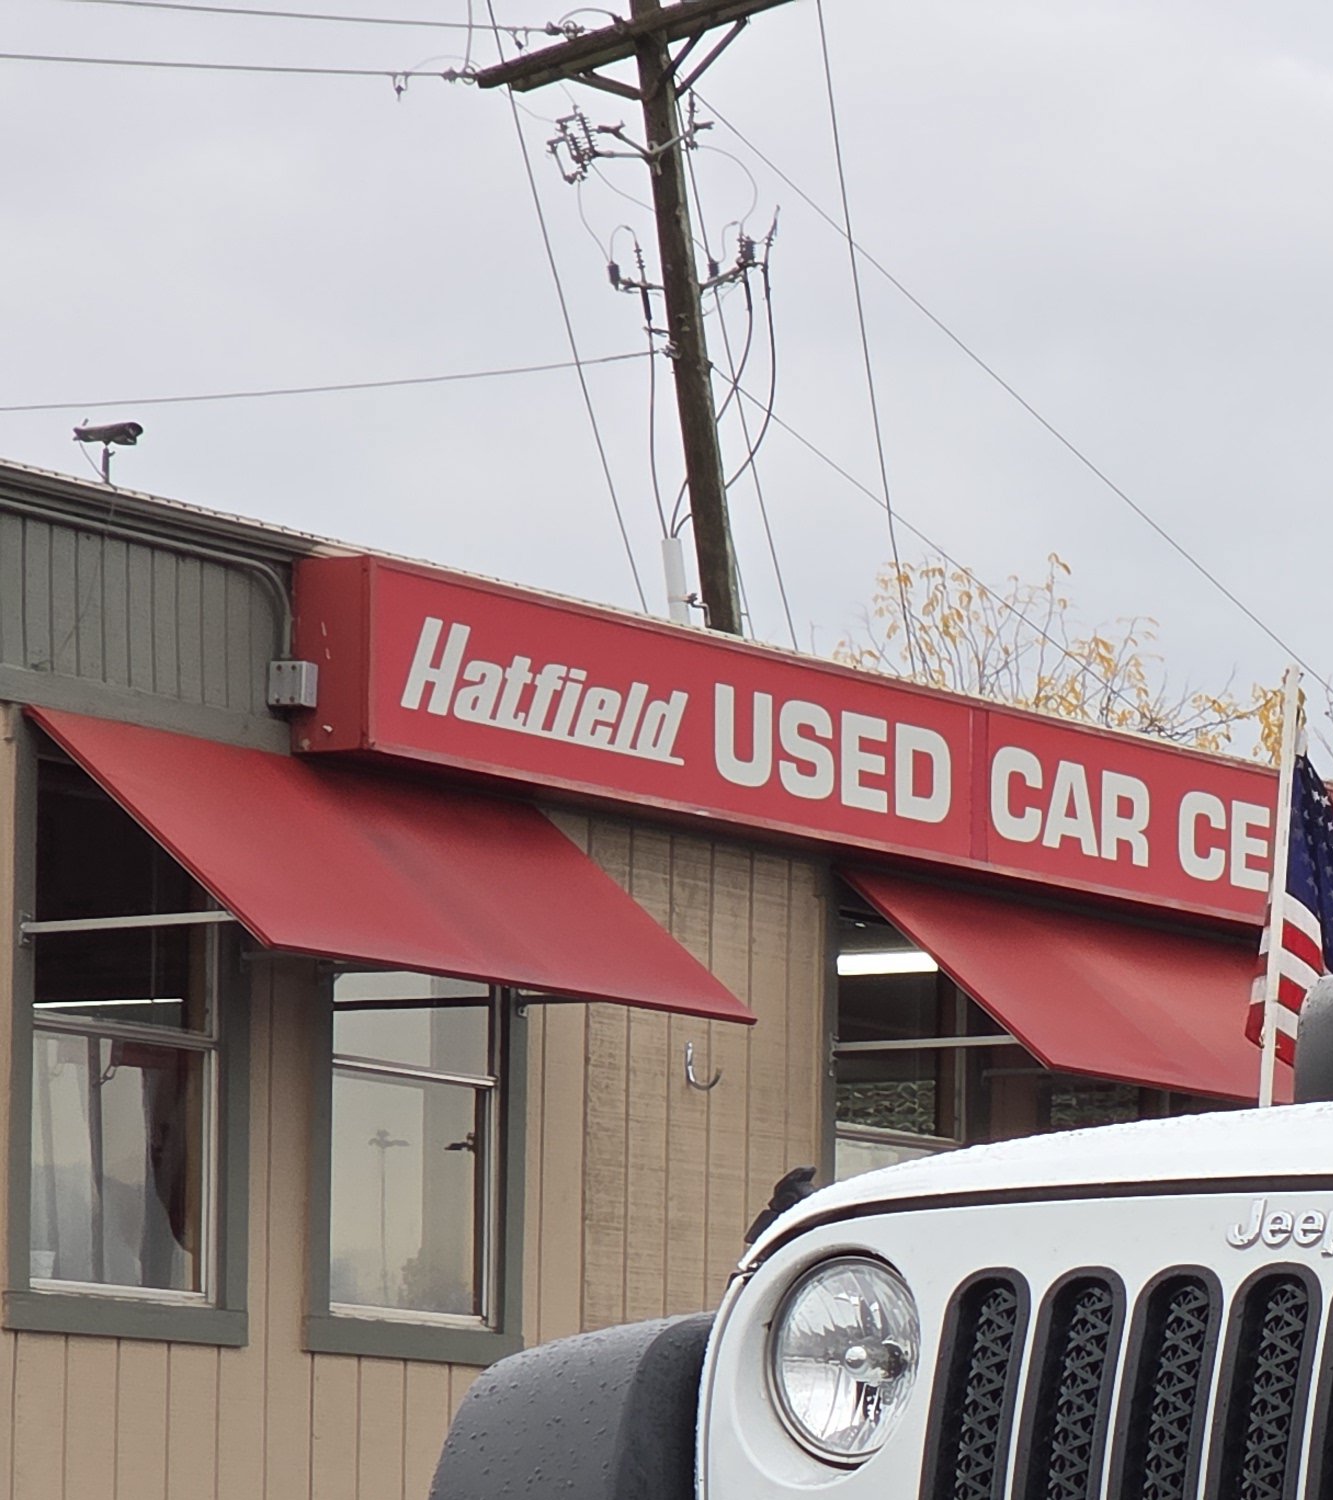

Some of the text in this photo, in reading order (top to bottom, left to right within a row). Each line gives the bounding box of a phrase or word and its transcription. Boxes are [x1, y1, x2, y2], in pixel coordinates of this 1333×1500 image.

[399, 615, 689, 766] Hatfield
[713, 682, 952, 823] USED
[989, 747, 1151, 868] CAR
